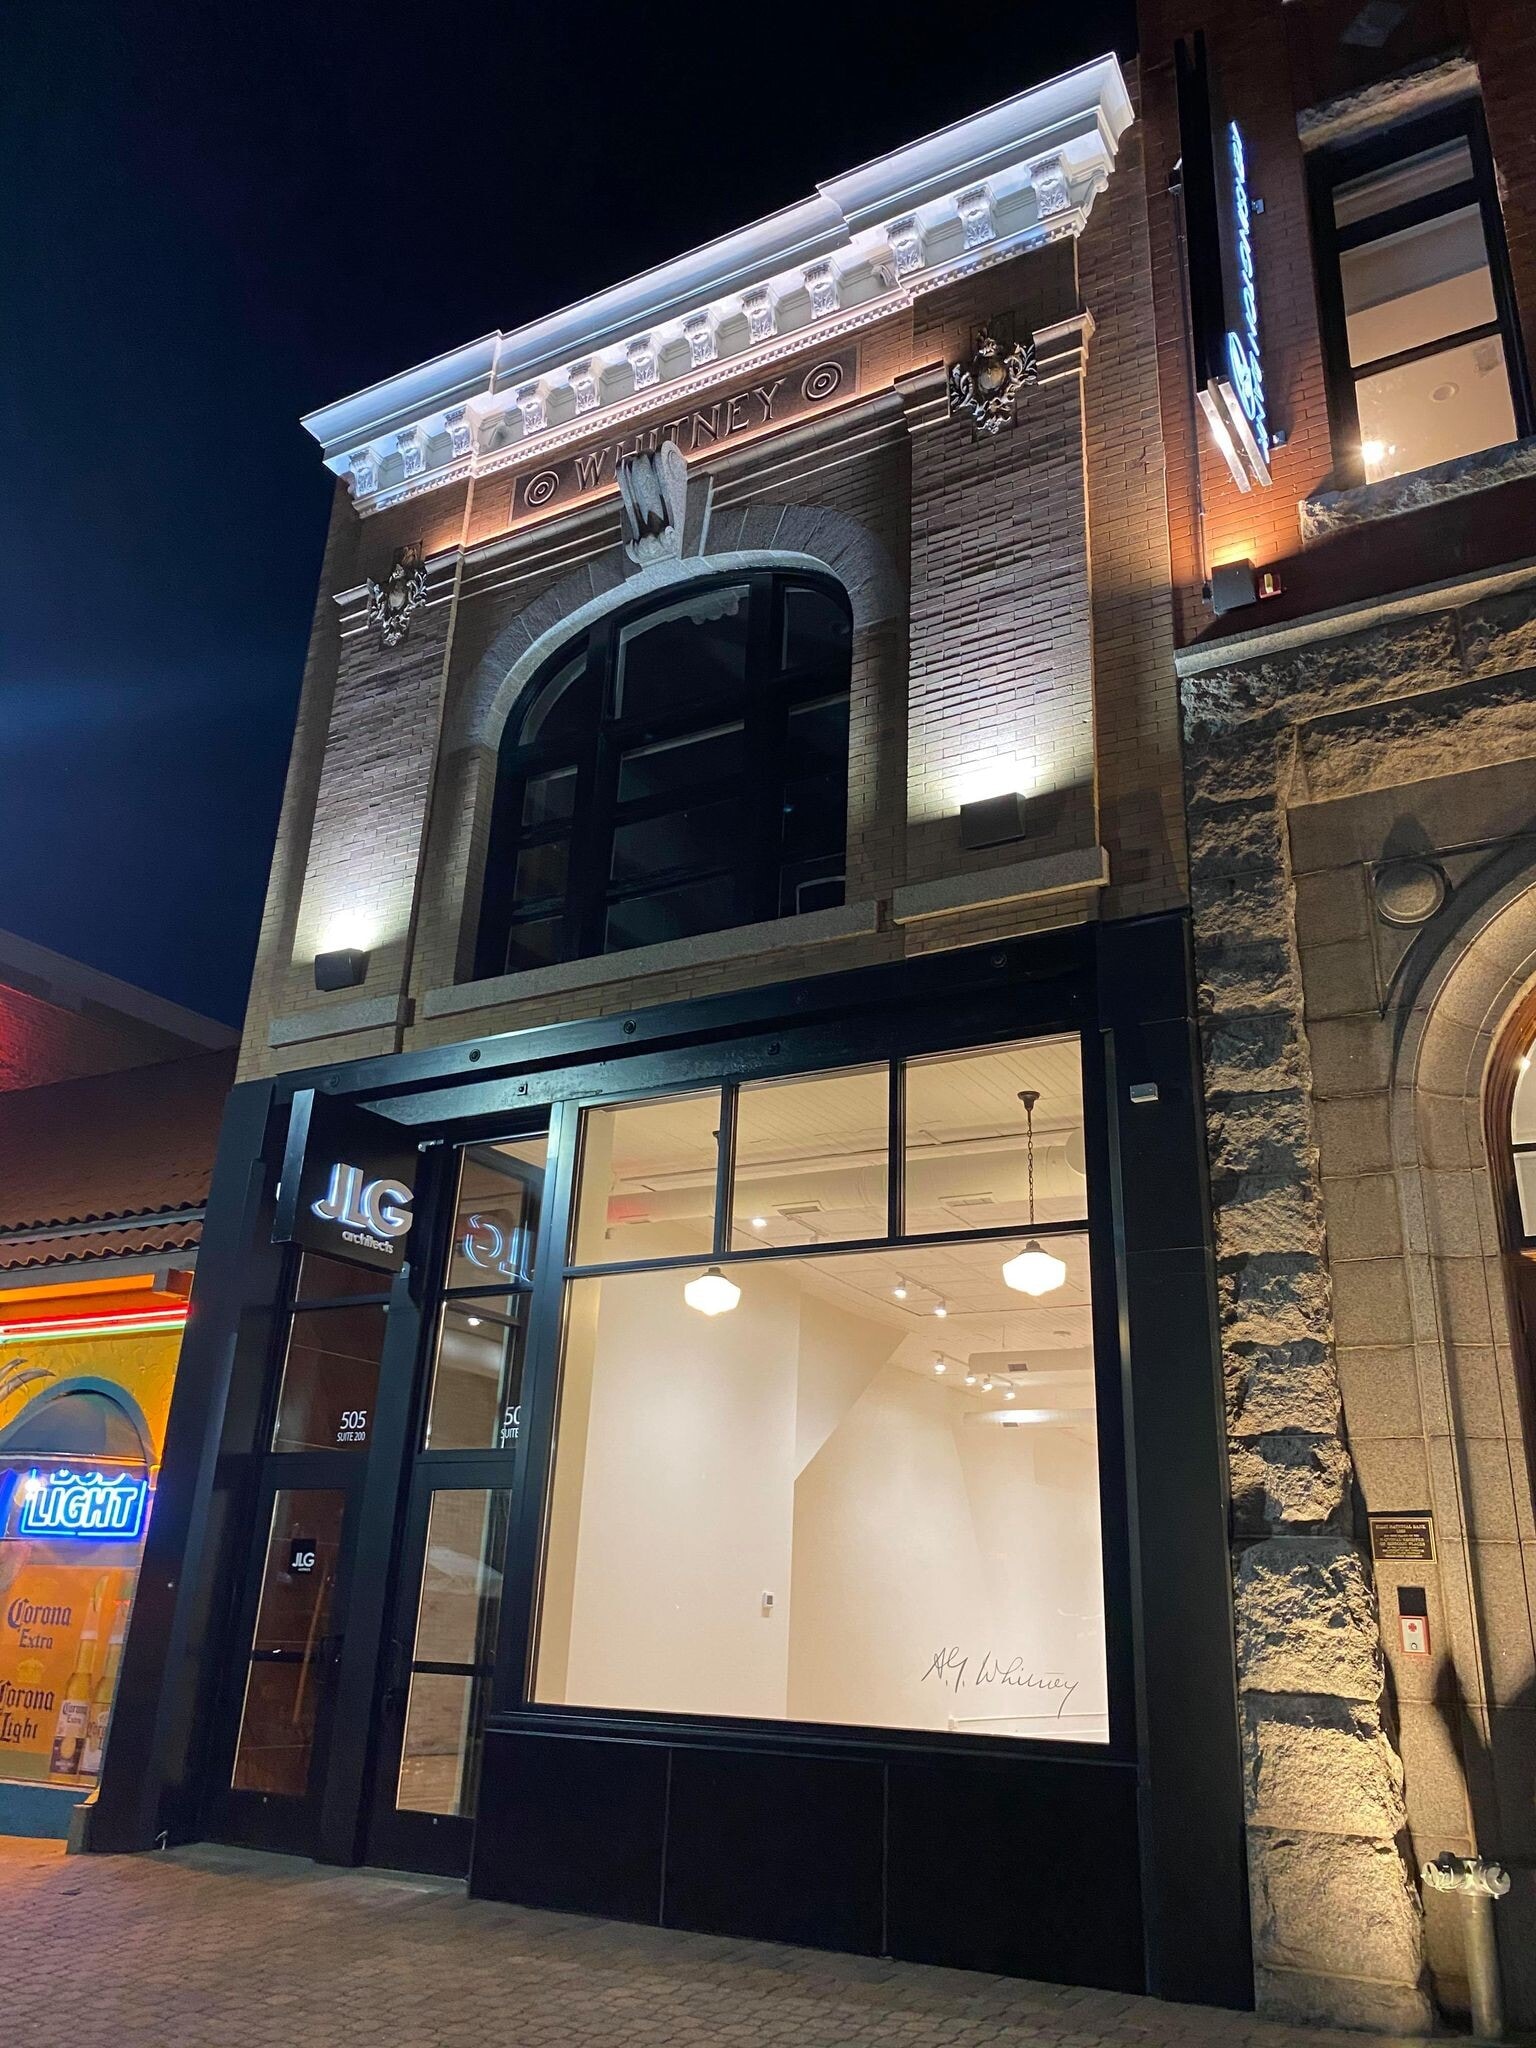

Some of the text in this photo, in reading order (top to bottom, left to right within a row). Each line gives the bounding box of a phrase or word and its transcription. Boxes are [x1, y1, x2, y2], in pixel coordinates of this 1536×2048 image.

[574, 377, 788, 492] WHITNEY
[312, 1163, 415, 1238] JLG
[342, 1230, 394, 1254] architects
[340, 1410, 367, 1430] 505
[336, 1431, 366, 1442] SUITE 200
[26, 1485, 139, 1528] LIGHT
[291, 1552, 315, 1568] JLG
[8, 1598, 72, 1629] Corona
[17, 1627, 54, 1650] Extra
[0, 1710, 39, 1744] Light
